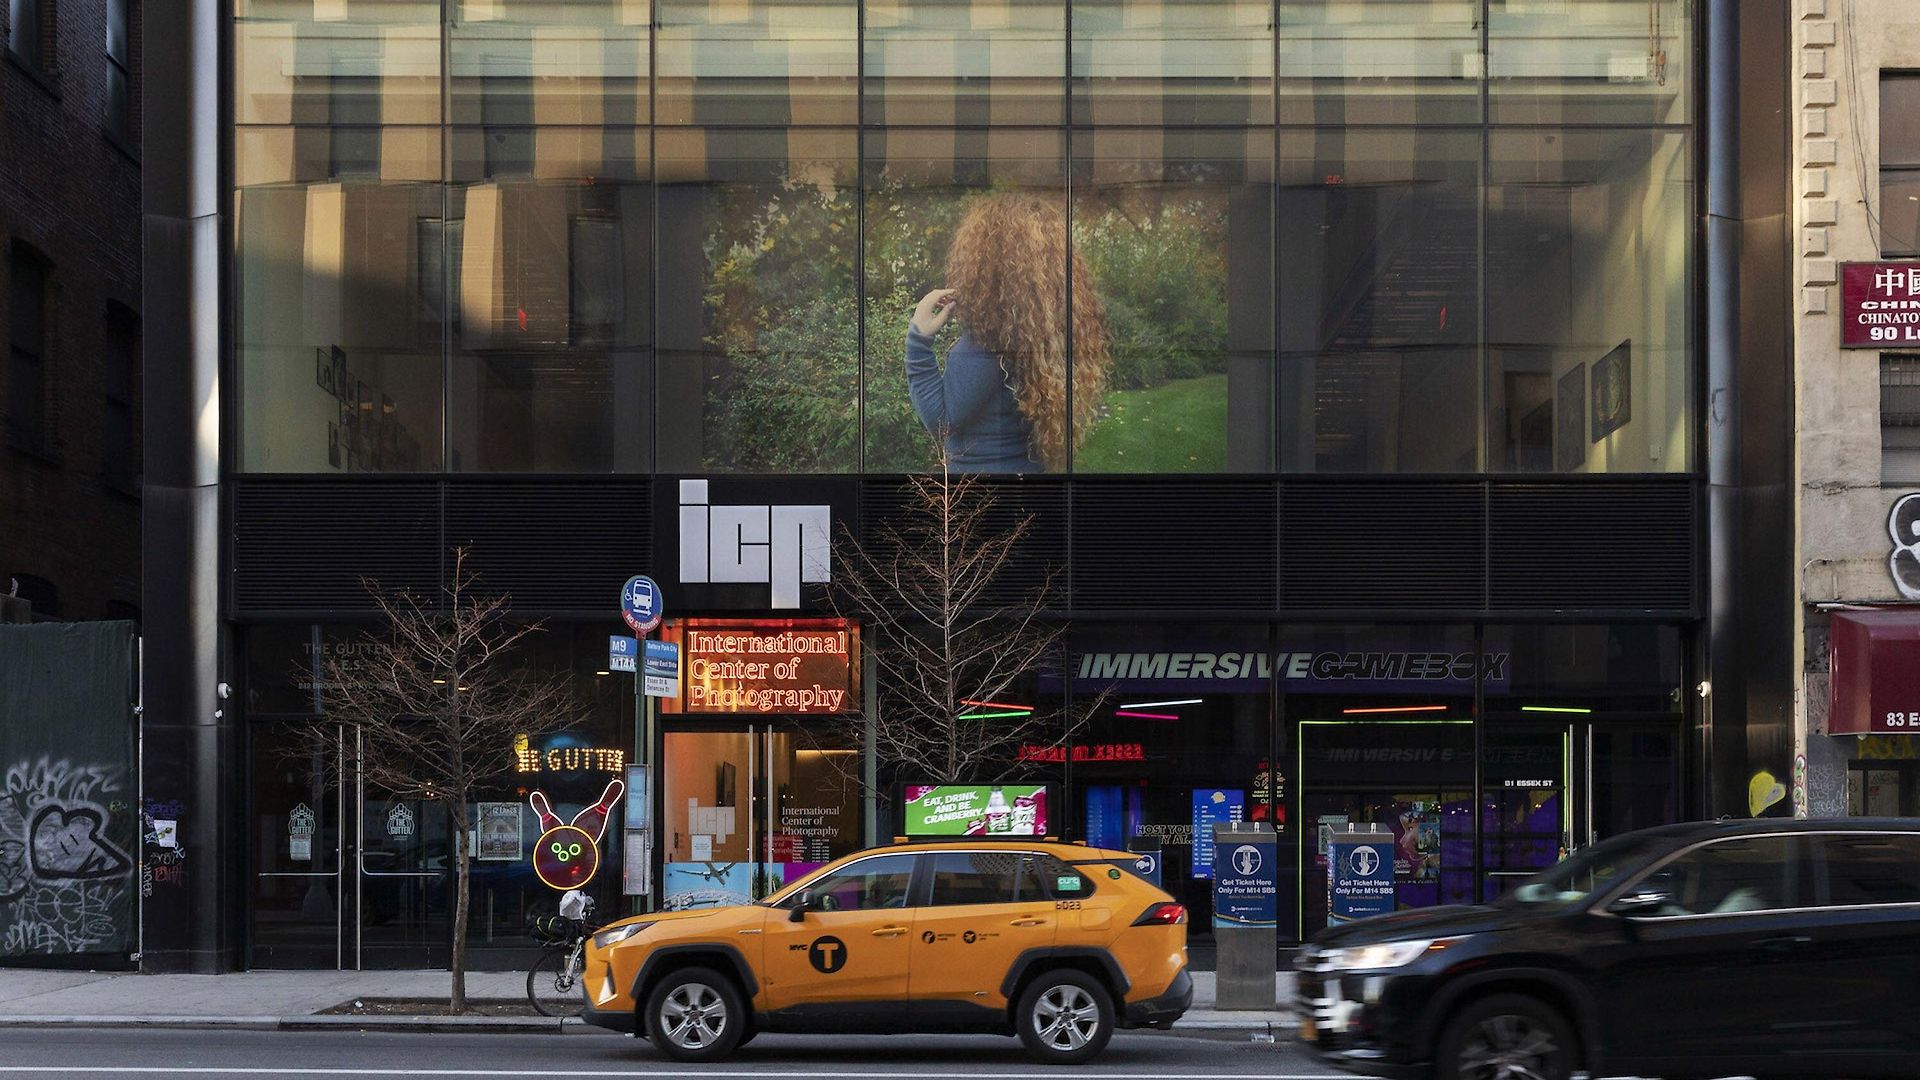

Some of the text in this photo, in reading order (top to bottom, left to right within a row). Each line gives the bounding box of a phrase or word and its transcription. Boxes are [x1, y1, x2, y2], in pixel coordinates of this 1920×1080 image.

[1870, 326, 1898, 341] 90
[679, 479, 831, 609] icp
[625, 613, 634, 624] NO
[612, 639, 626, 652] M9
[688, 631, 847, 654] International
[690, 657, 799, 679] Center of
[690, 684, 845, 712] Photography
[1886, 712, 1920, 727] 83 E
[547, 748, 625, 772] GUTTER
[1542, 779, 1553, 787] ST
[781, 806, 840, 815] International
[933, 801, 972, 815] AND BE
[781, 816, 824, 826] Center of
[781, 826, 839, 837] Photography
[1135, 824, 1167, 835] HOST
[1221, 878, 1272, 886] Get Ticket Here
[1339, 879, 1352, 887] Get
[1352, 879, 1373, 887] Ticket
[1374, 879, 1390, 887] Here
[1218, 886, 1233, 895] Only
[1261, 886, 1277, 894] SBS
[1335, 887, 1351, 895] Only
[1379, 887, 1394, 895] SBS
